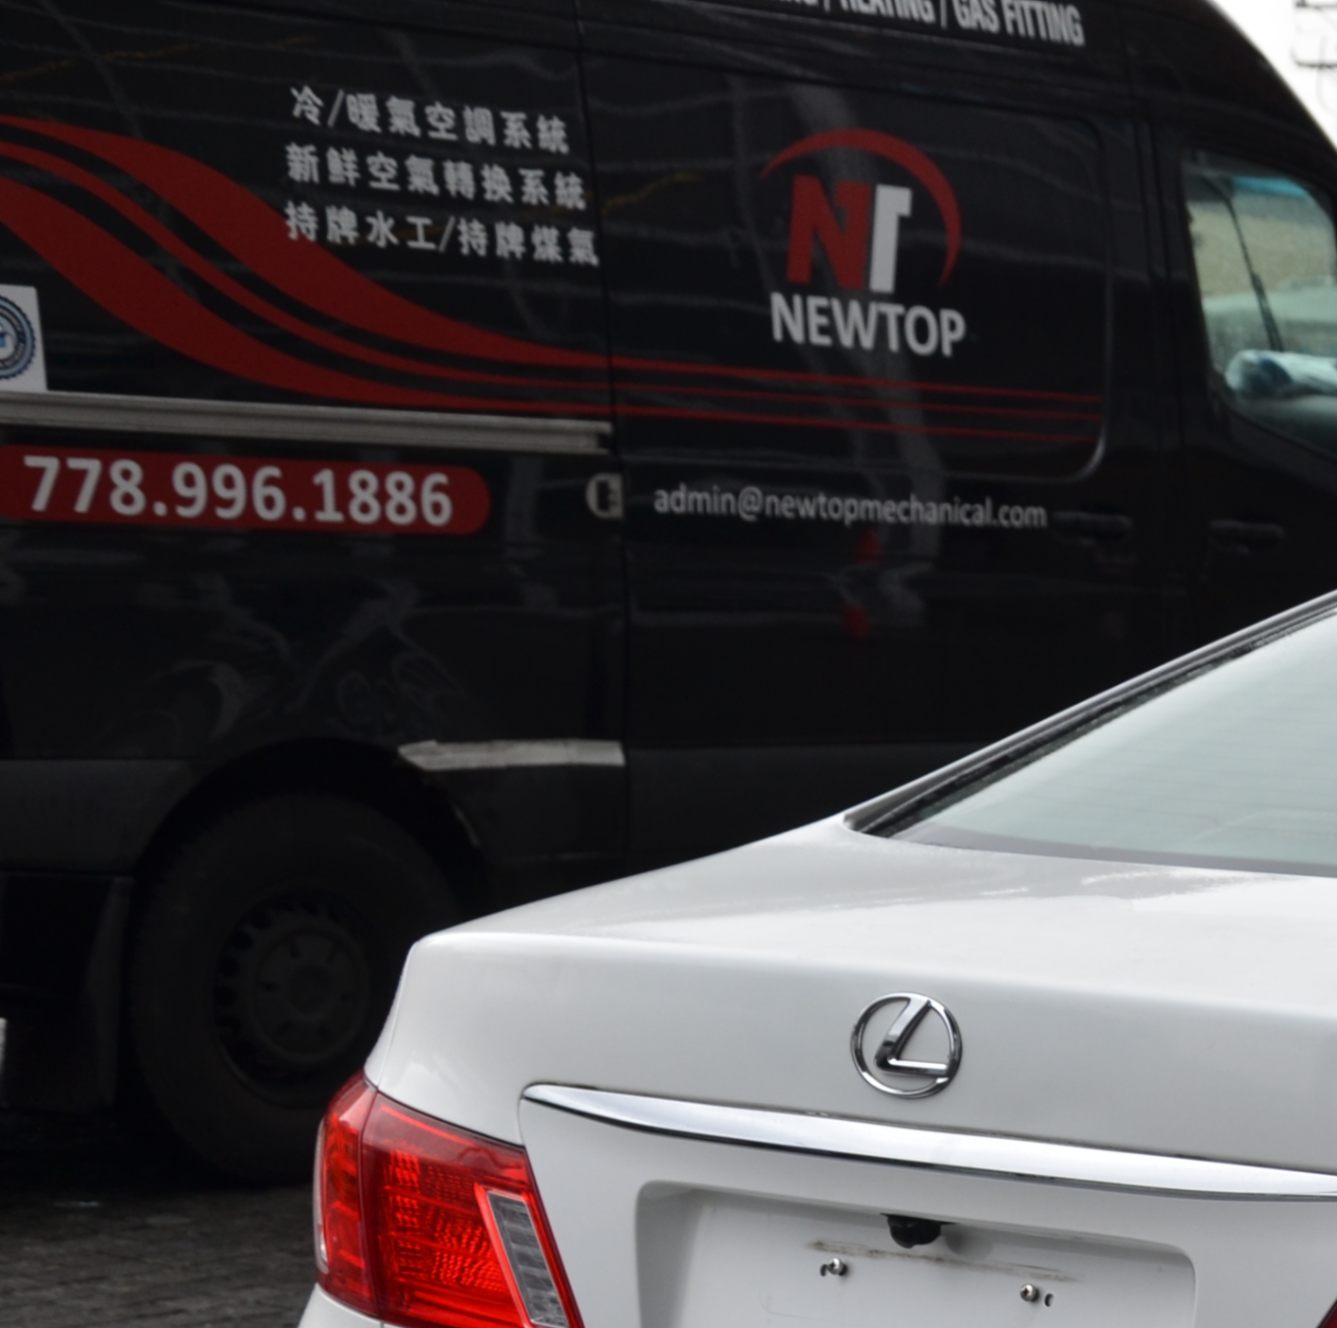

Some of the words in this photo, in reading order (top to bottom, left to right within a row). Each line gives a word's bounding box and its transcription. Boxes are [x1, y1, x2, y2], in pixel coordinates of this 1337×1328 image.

[952, 0, 1000, 33] GAS
[1002, 1, 1086, 46] FITTING
[769, 291, 967, 358] NEWTOP
[23, 455, 454, 527] 778.996.1886
[653, 481, 1049, 528] admin@newtopmechanical.com
